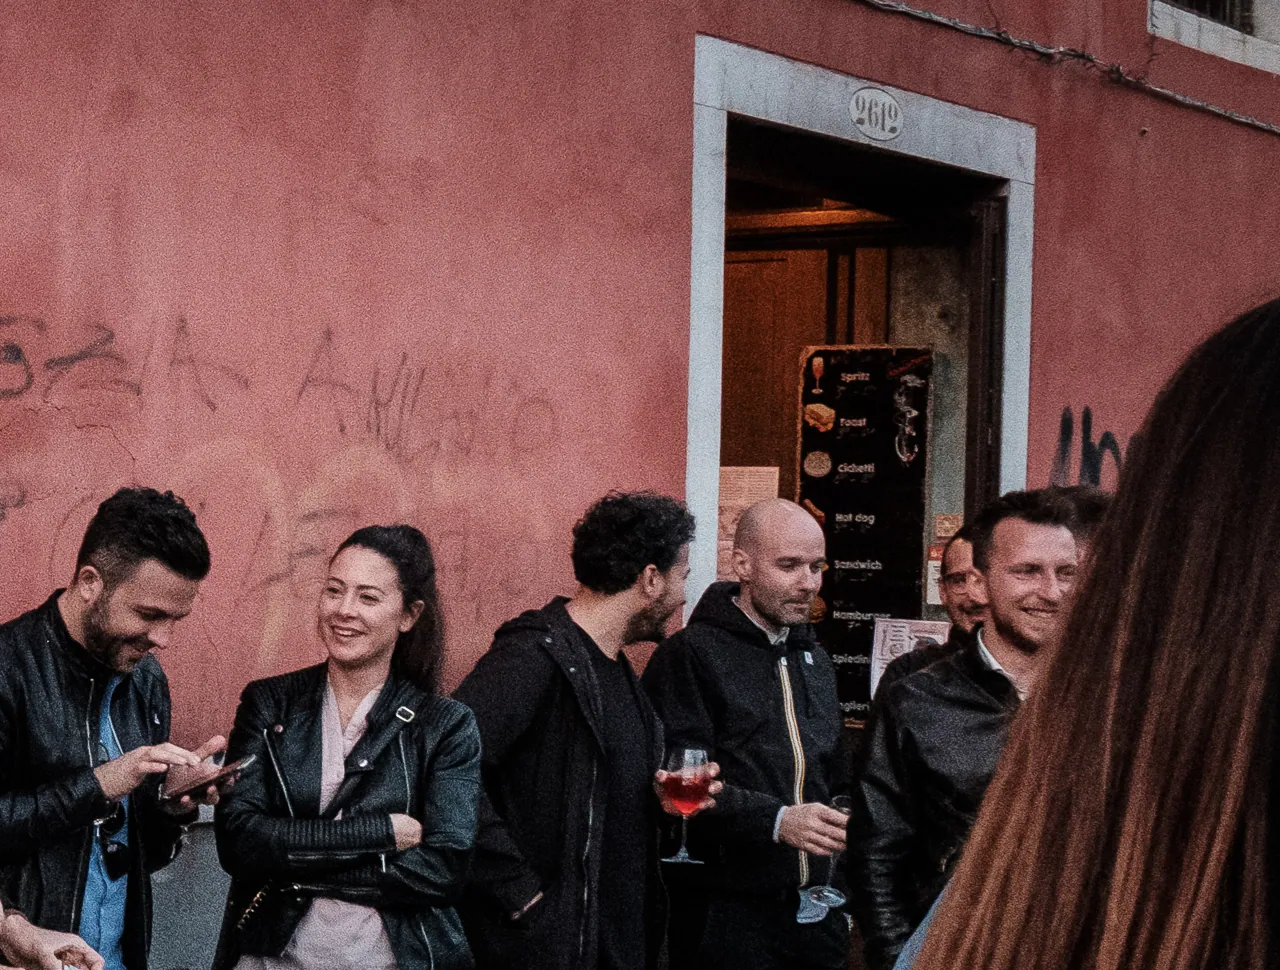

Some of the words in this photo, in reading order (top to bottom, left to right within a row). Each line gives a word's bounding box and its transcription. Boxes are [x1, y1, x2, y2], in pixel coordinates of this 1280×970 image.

[839, 370, 871, 384] Spritz
[839, 417, 868, 428] Toast
[835, 512, 853, 523] Hot
[854, 512, 876, 526] dog
[833, 559, 883, 571] Sandwich
[832, 652, 870, 666] Spiedin
